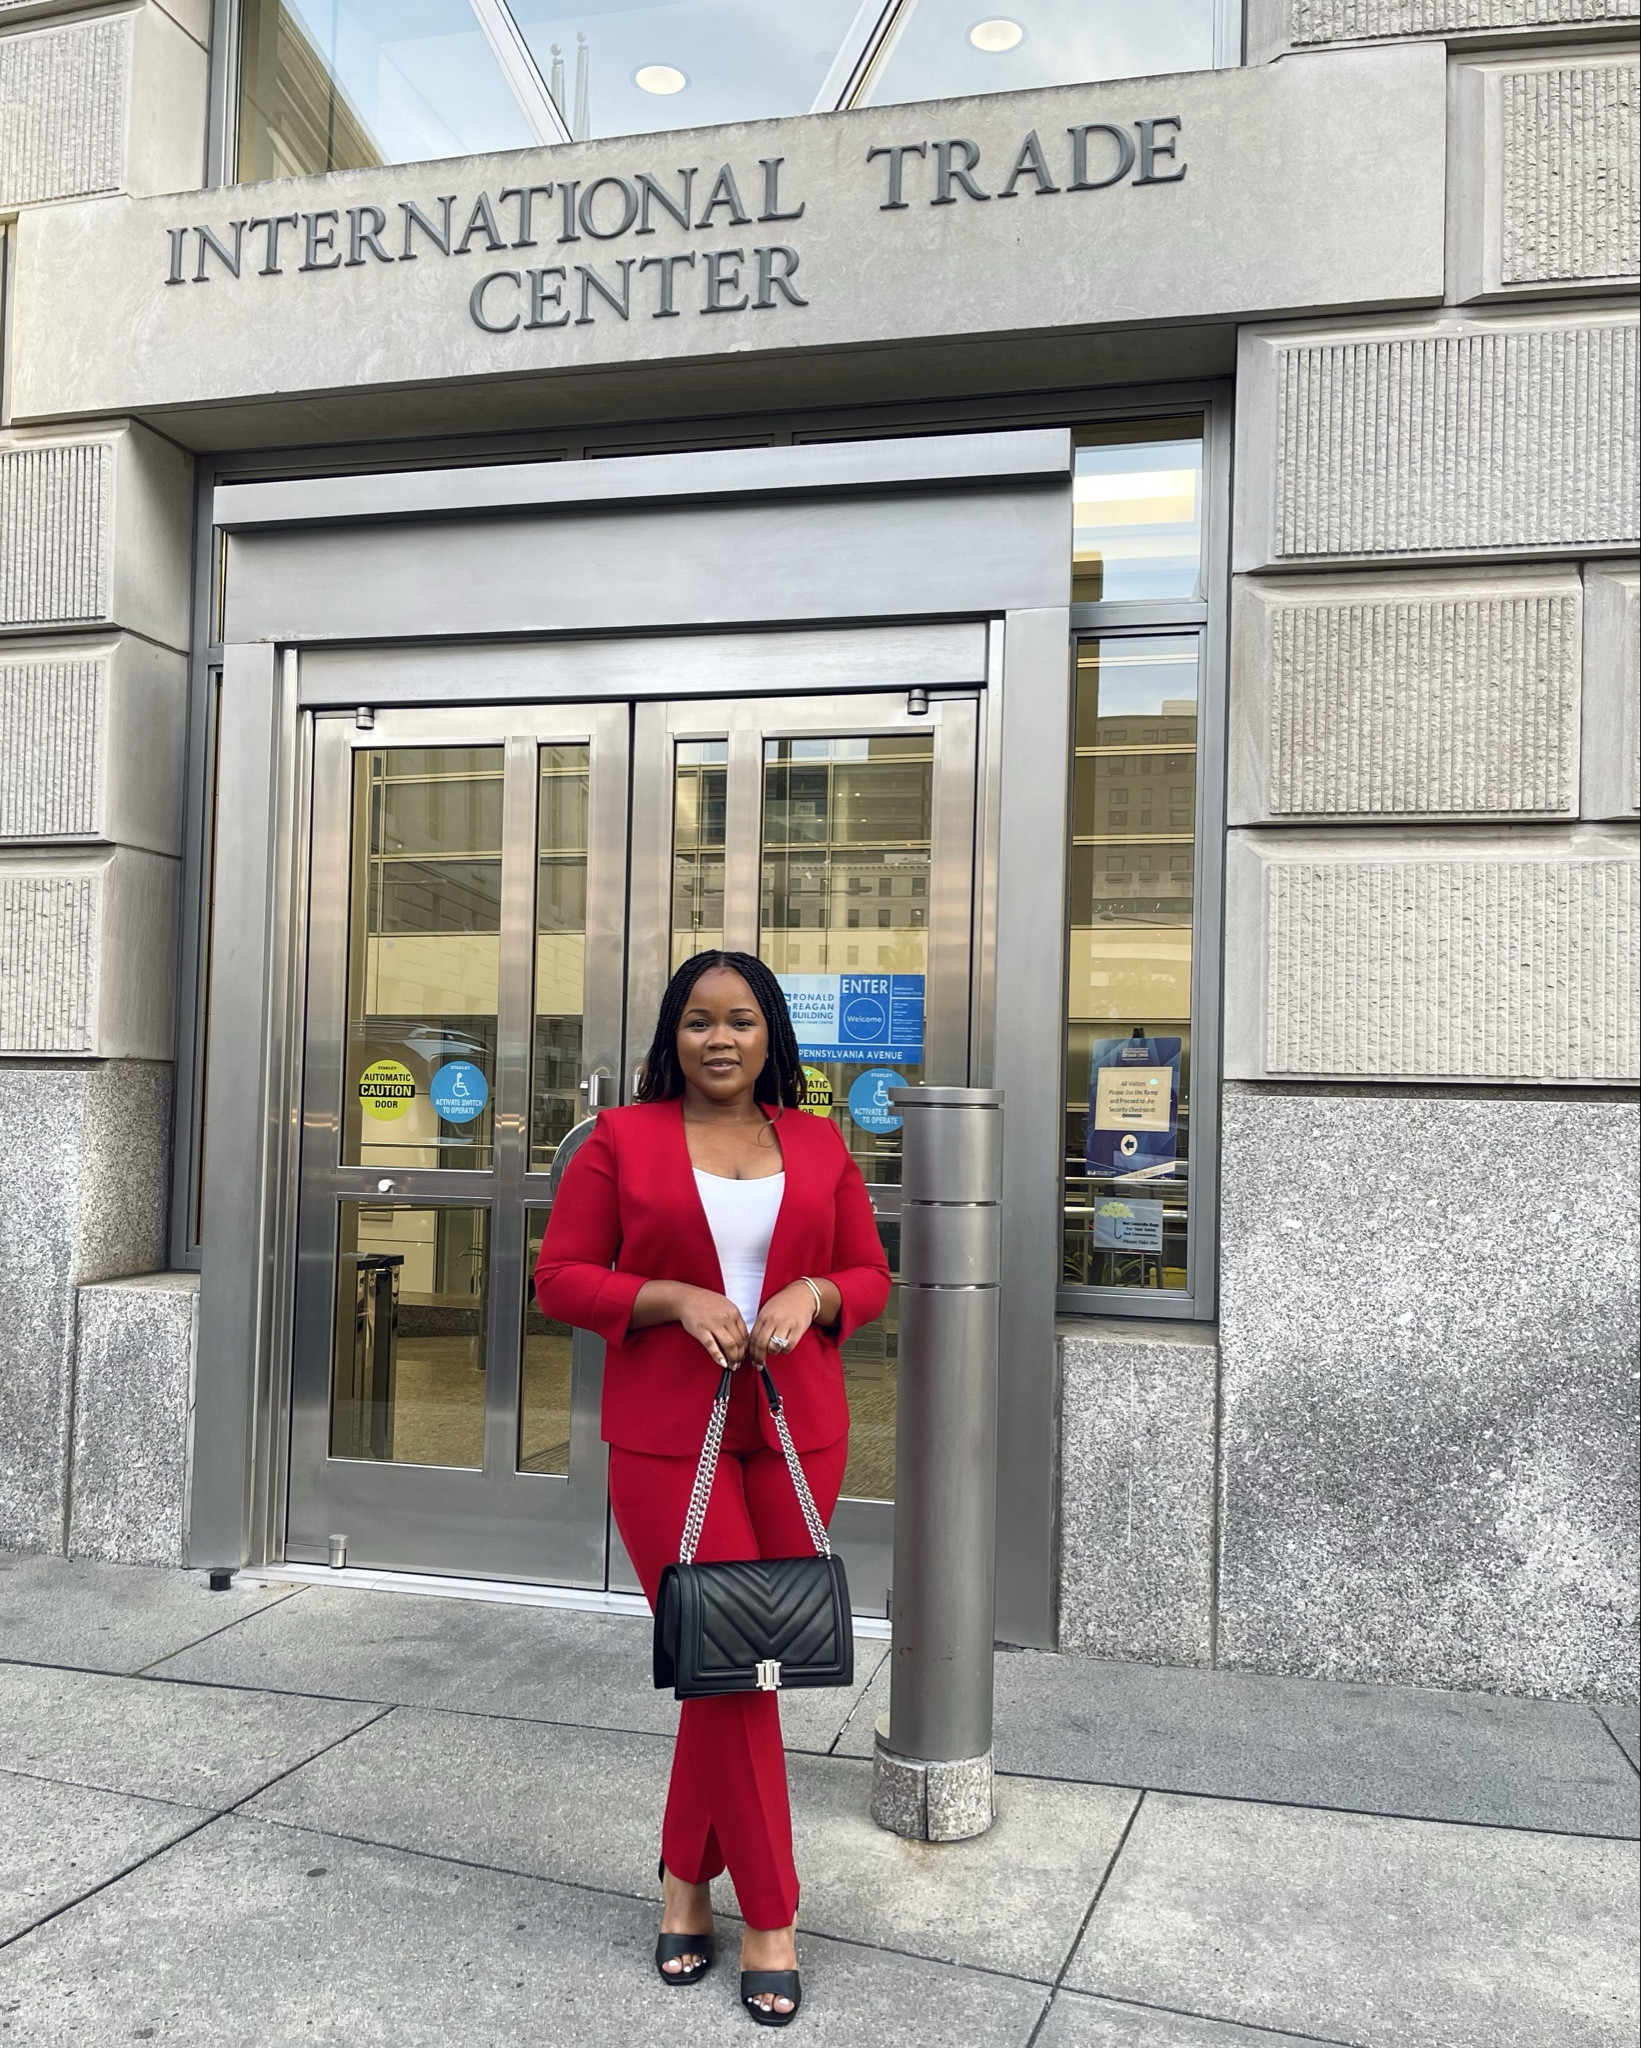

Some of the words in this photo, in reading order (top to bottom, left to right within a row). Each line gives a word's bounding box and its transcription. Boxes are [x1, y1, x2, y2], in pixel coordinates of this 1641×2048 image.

[164, 156, 806, 285] INTERNATIONAL
[866, 115, 1188, 211] TRADE
[469, 244, 809, 333] CENTER
[842, 979, 888, 994] ENTER
[793, 993, 834, 1001] RONALD
[799, 1049, 864, 1059] PENNSYLVANIA
[866, 1051, 903, 1060] AVENUE
[364, 1073, 411, 1082] AUTOMATIC
[360, 1085, 412, 1096] CAUTION
[375, 1100, 398, 1108] DOOR
[451, 1107, 475, 1115] OPERATE
[854, 1108, 882, 1116] ACTIVATE
